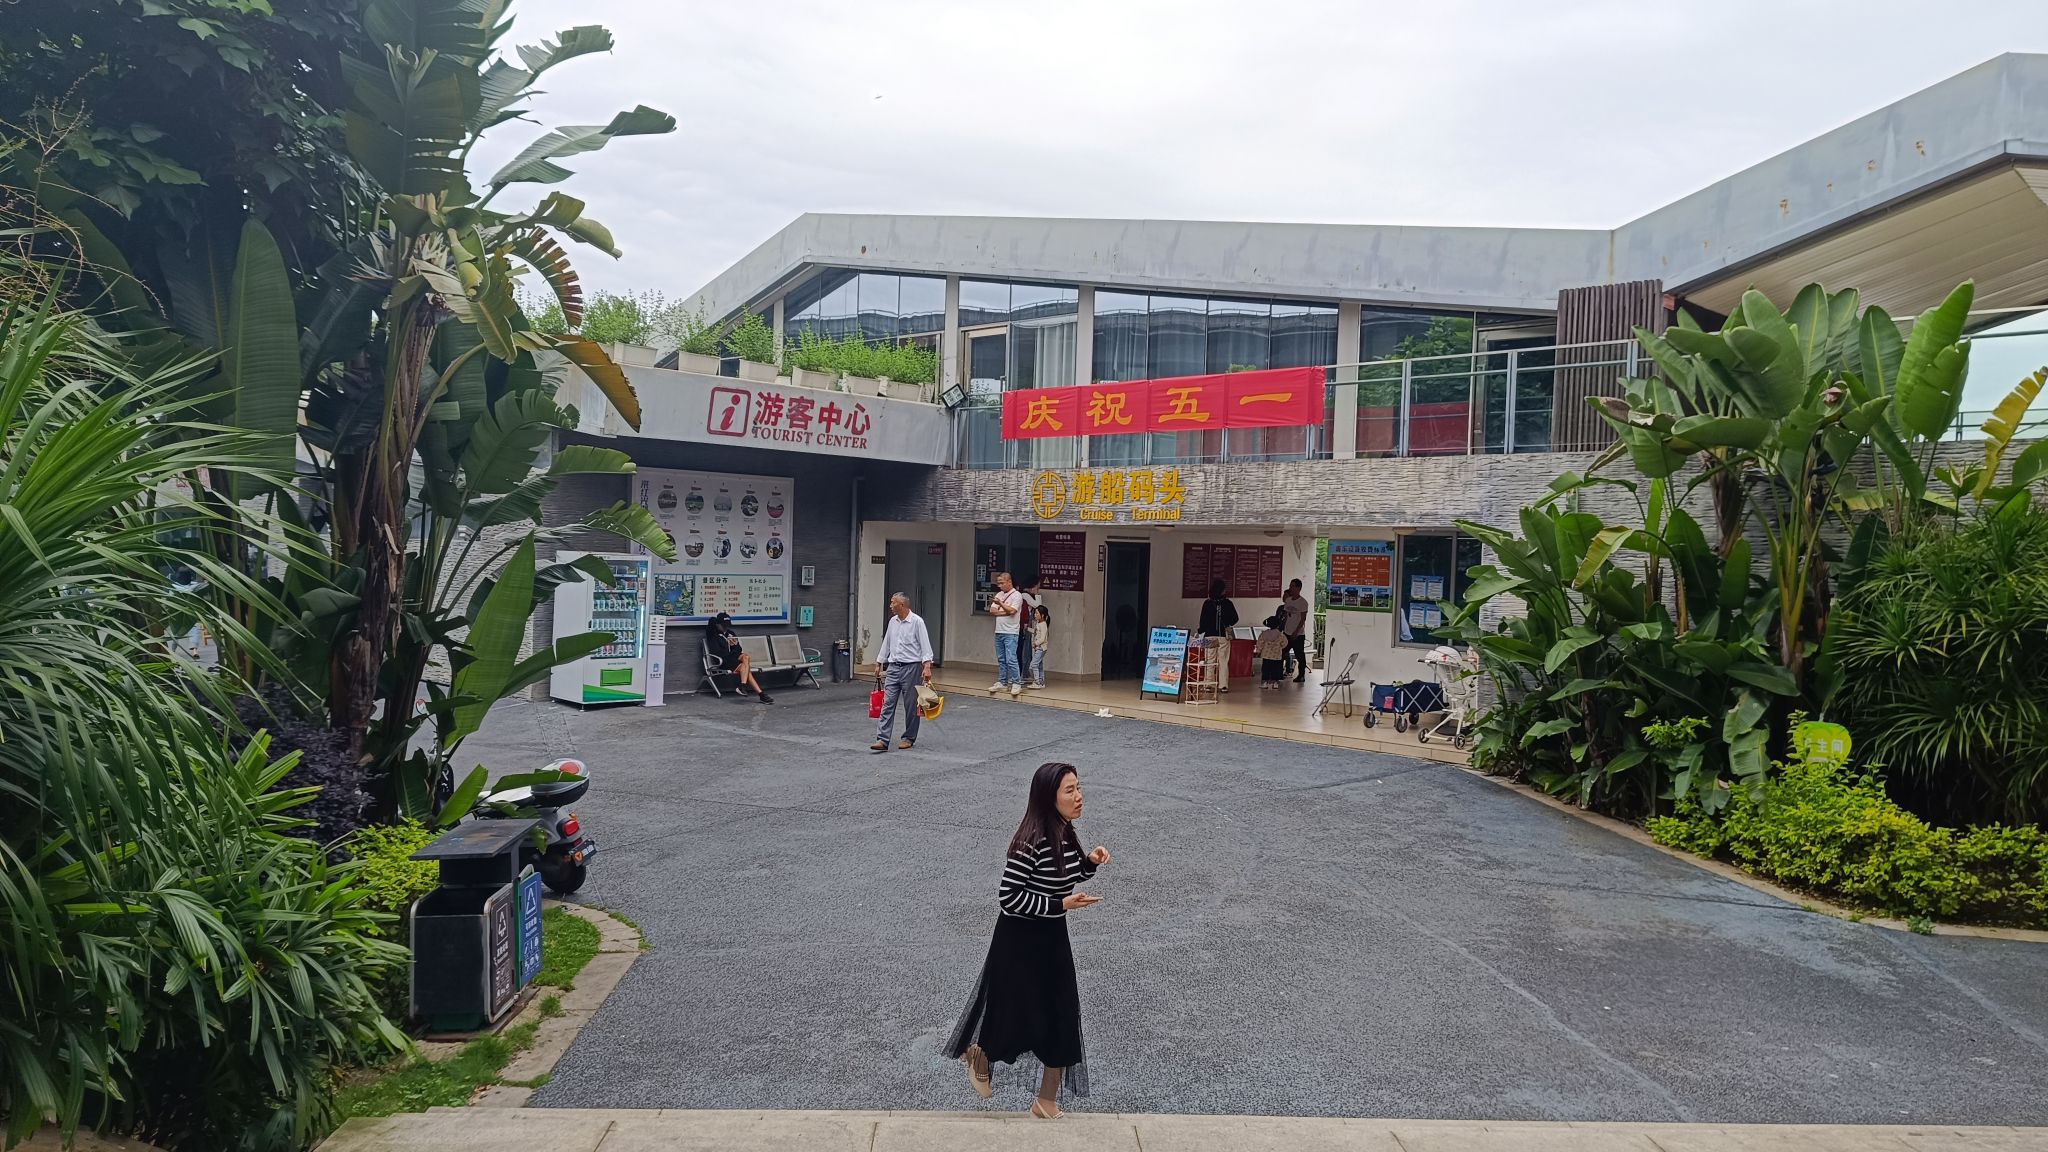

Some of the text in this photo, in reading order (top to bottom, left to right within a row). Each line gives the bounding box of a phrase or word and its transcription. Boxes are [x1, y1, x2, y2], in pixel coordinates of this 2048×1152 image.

[755, 391, 871, 436] 游客中心
[1020, 387, 1292, 431] 庆祝五一
[753, 426, 868, 449] TOURIST CENTER
[1071, 470, 1185, 505] 游船码头
[1080, 508, 1181, 521] Cruise Terminal
